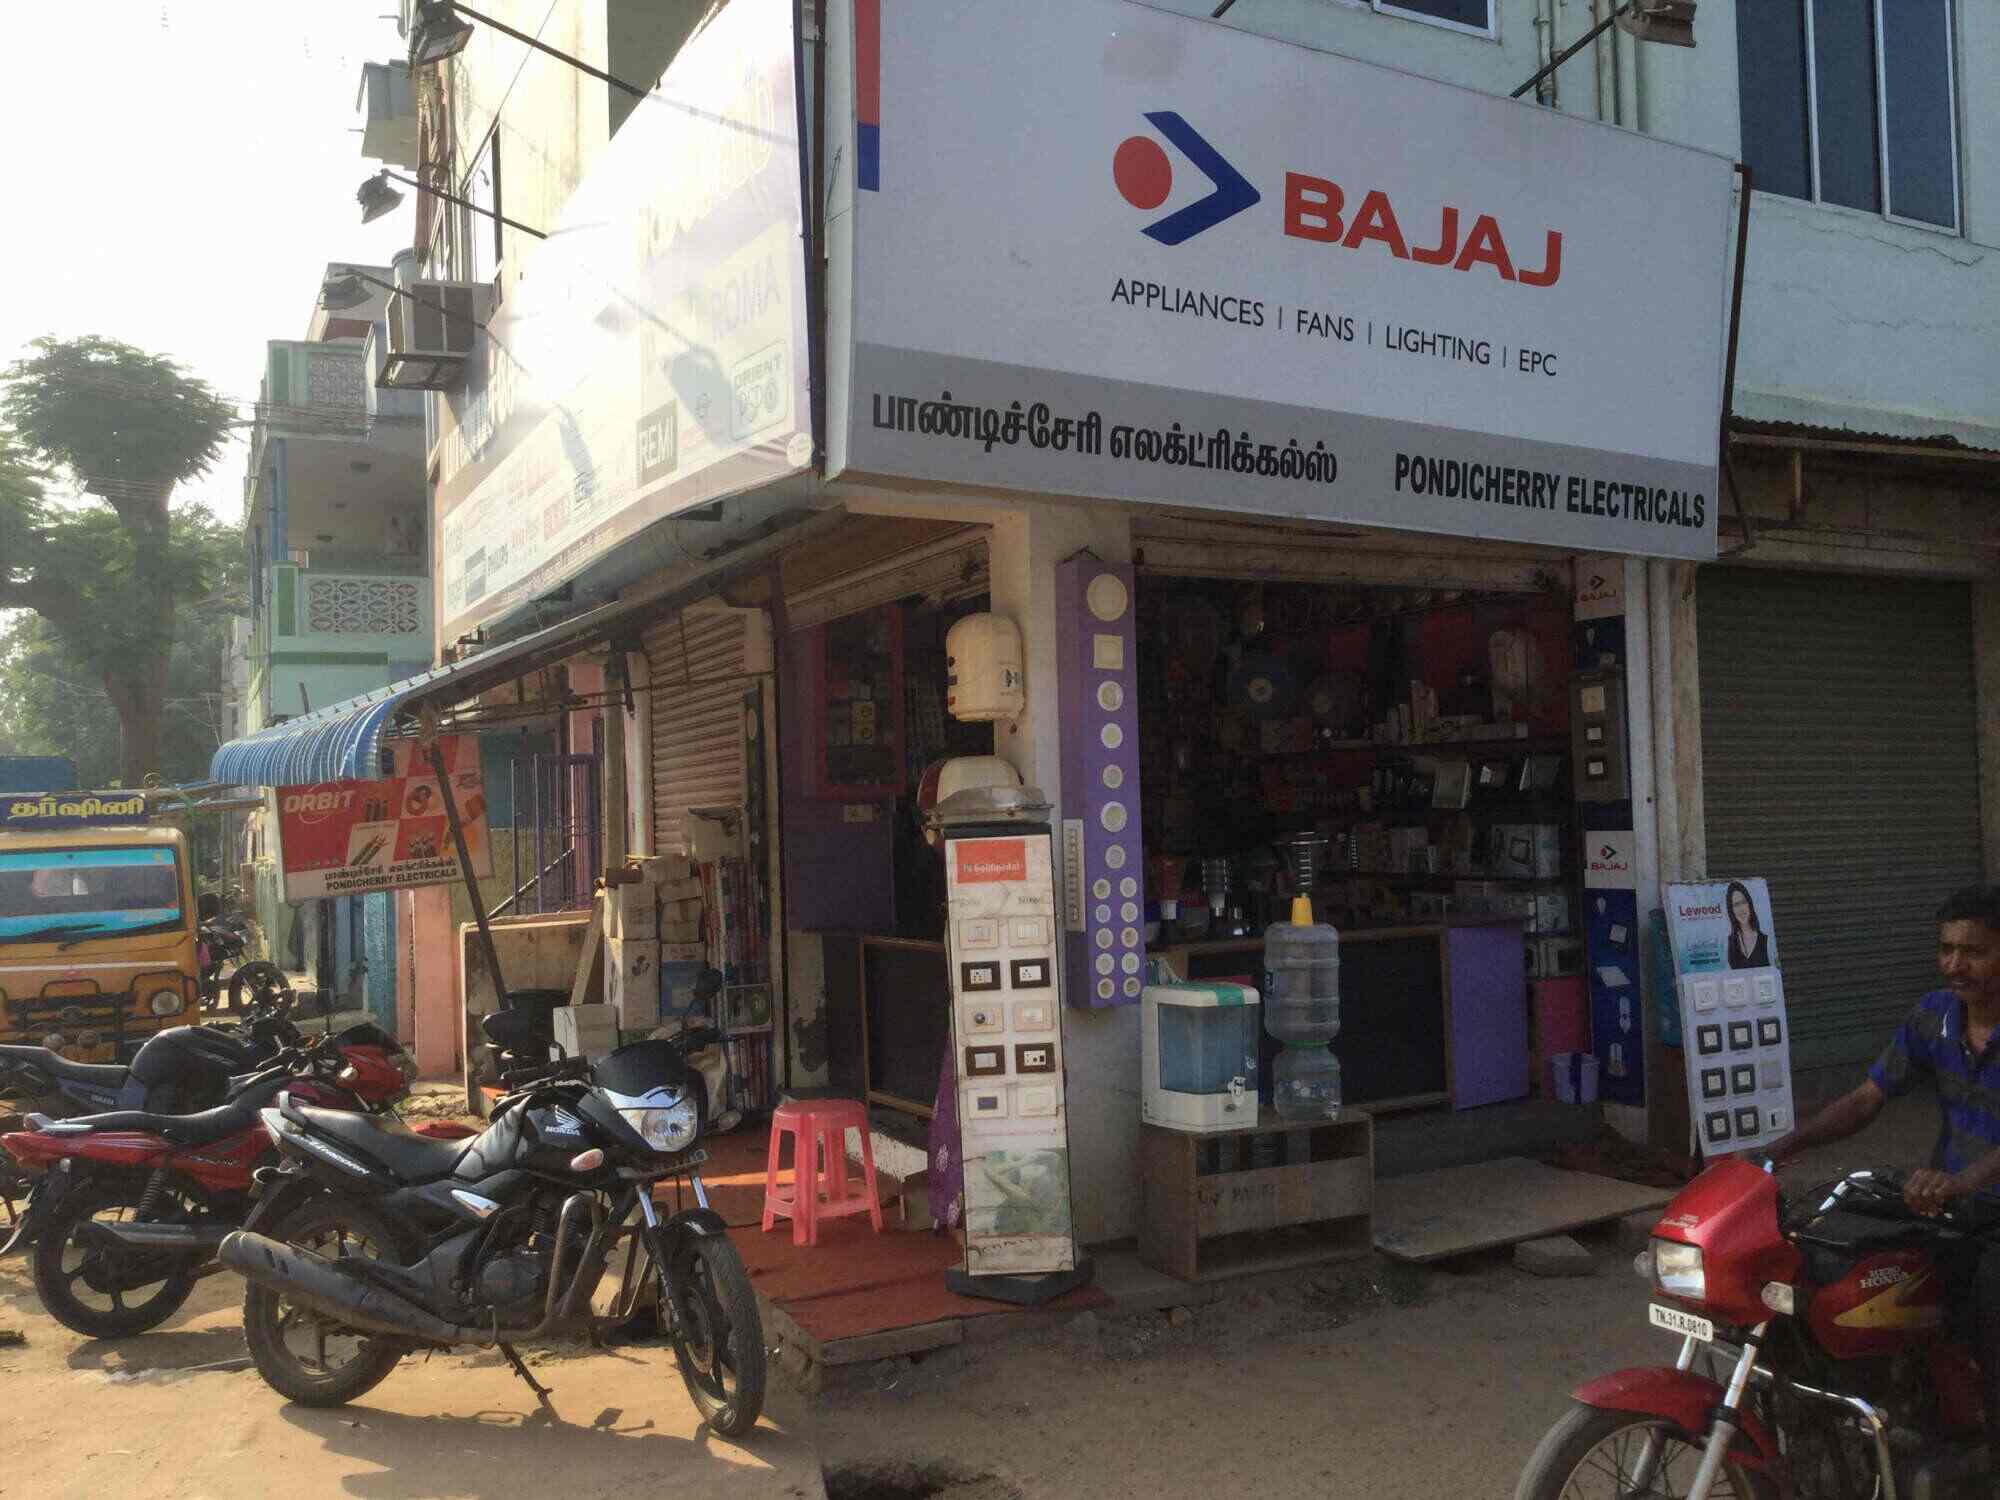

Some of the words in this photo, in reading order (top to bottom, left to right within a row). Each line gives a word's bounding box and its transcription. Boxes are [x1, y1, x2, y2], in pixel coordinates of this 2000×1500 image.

[1283, 171, 1562, 287] BAJAJ
[1112, 278, 1265, 327] APPLIANCES
[1296, 309, 1354, 342] FANS
[1385, 325, 1490, 365] LIGHTING
[1519, 349, 1557, 376] EPC
[640, 413, 674, 470] REMI
[872, 390, 1102, 455] பாண்டிச்சேரி
[1110, 422, 1337, 483] எலக்ட்ரிக்கல்ஸ்
[1395, 453, 1560, 510] PONDICHERRY
[1566, 476, 1705, 529] ELECTRICALS
[326, 875, 393, 891] PONDICHERRY
[396, 868, 457, 884] ELECTRICALS
[1591, 861, 1628, 872] BAJAJ
[545, 1125, 580, 1136] HONDA
